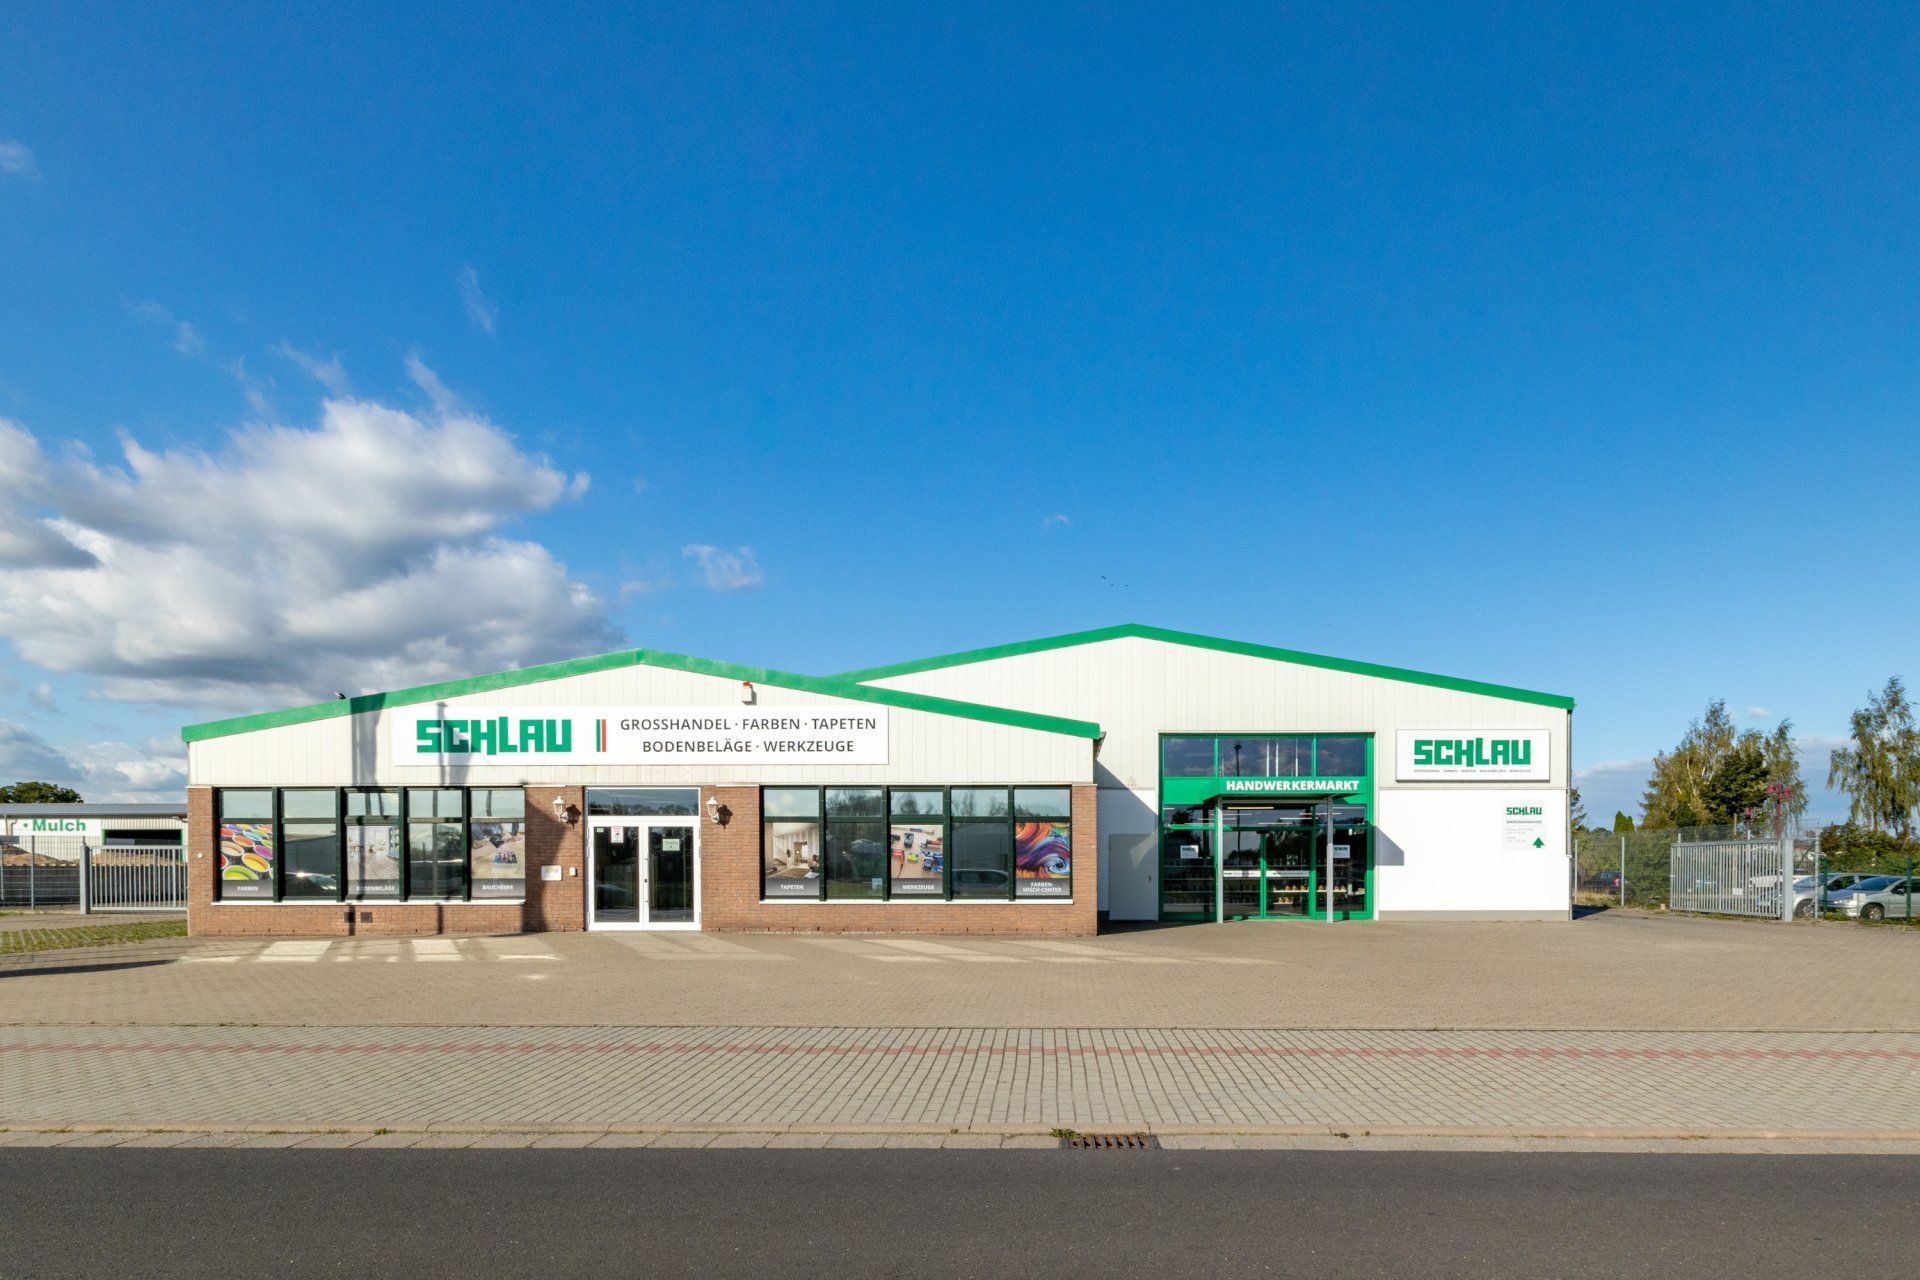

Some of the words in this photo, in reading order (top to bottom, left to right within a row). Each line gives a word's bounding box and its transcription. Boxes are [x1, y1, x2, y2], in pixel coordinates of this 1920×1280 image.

[620, 719, 731, 731] GROSSHANDEL
[742, 719, 800, 730] FARBEN
[811, 718, 876, 730] TAPETEN
[416, 716, 572, 755] SCHLAU
[642, 738, 752, 752] BODENBELÄGE
[763, 740, 854, 752] WERKZEUGE
[1414, 737, 1531, 767] SCHLAU
[1226, 780, 1359, 791] HANDWERKERMARKT
[1506, 806, 1542, 816] SCHLAU
[32, 818, 86, 831] Mulch
